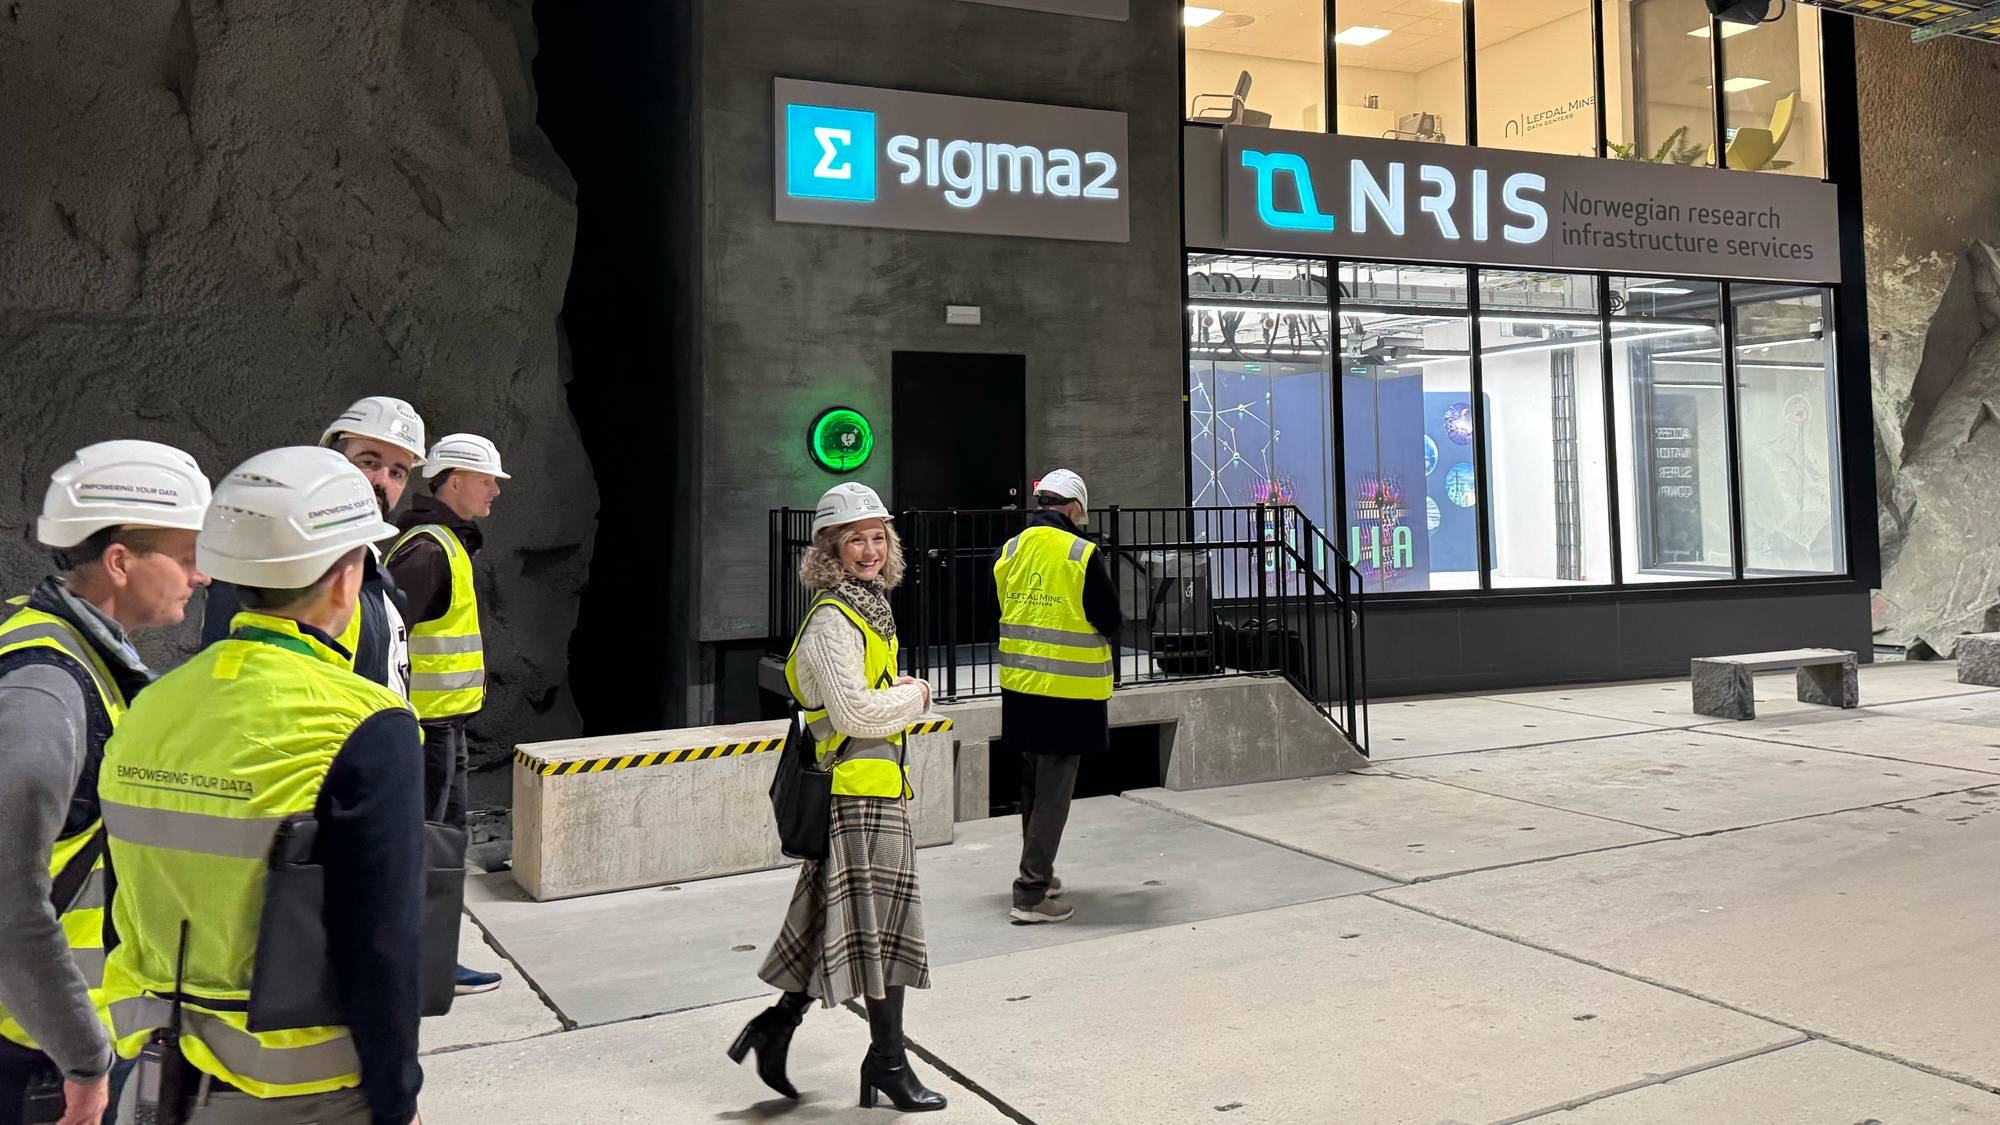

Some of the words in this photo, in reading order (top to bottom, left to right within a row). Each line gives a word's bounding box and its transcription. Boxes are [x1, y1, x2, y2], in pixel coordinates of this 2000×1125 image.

[1526, 106, 1567, 125] LEFDAL
[1568, 96, 1595, 112] MINE
[1527, 123, 1543, 132] DATA
[1544, 113, 1574, 126] CENTERS
[886, 134, 1119, 208] sigma2
[1350, 158, 1549, 246] NRIS
[1562, 190, 1680, 227] Norwegian
[1688, 206, 1781, 229] research
[1562, 222, 1719, 254] infrastructure
[1726, 236, 1814, 260] services
[80, 483, 134, 492] EMPOWERING
[135, 486, 157, 495] YOUR
[158, 489, 178, 497] DATA
[1039, 593, 1062, 604] MINE
[117, 765, 188, 785] EMPOWERING
[190, 773, 218, 789] YOUR
[220, 779, 254, 794] DATA
